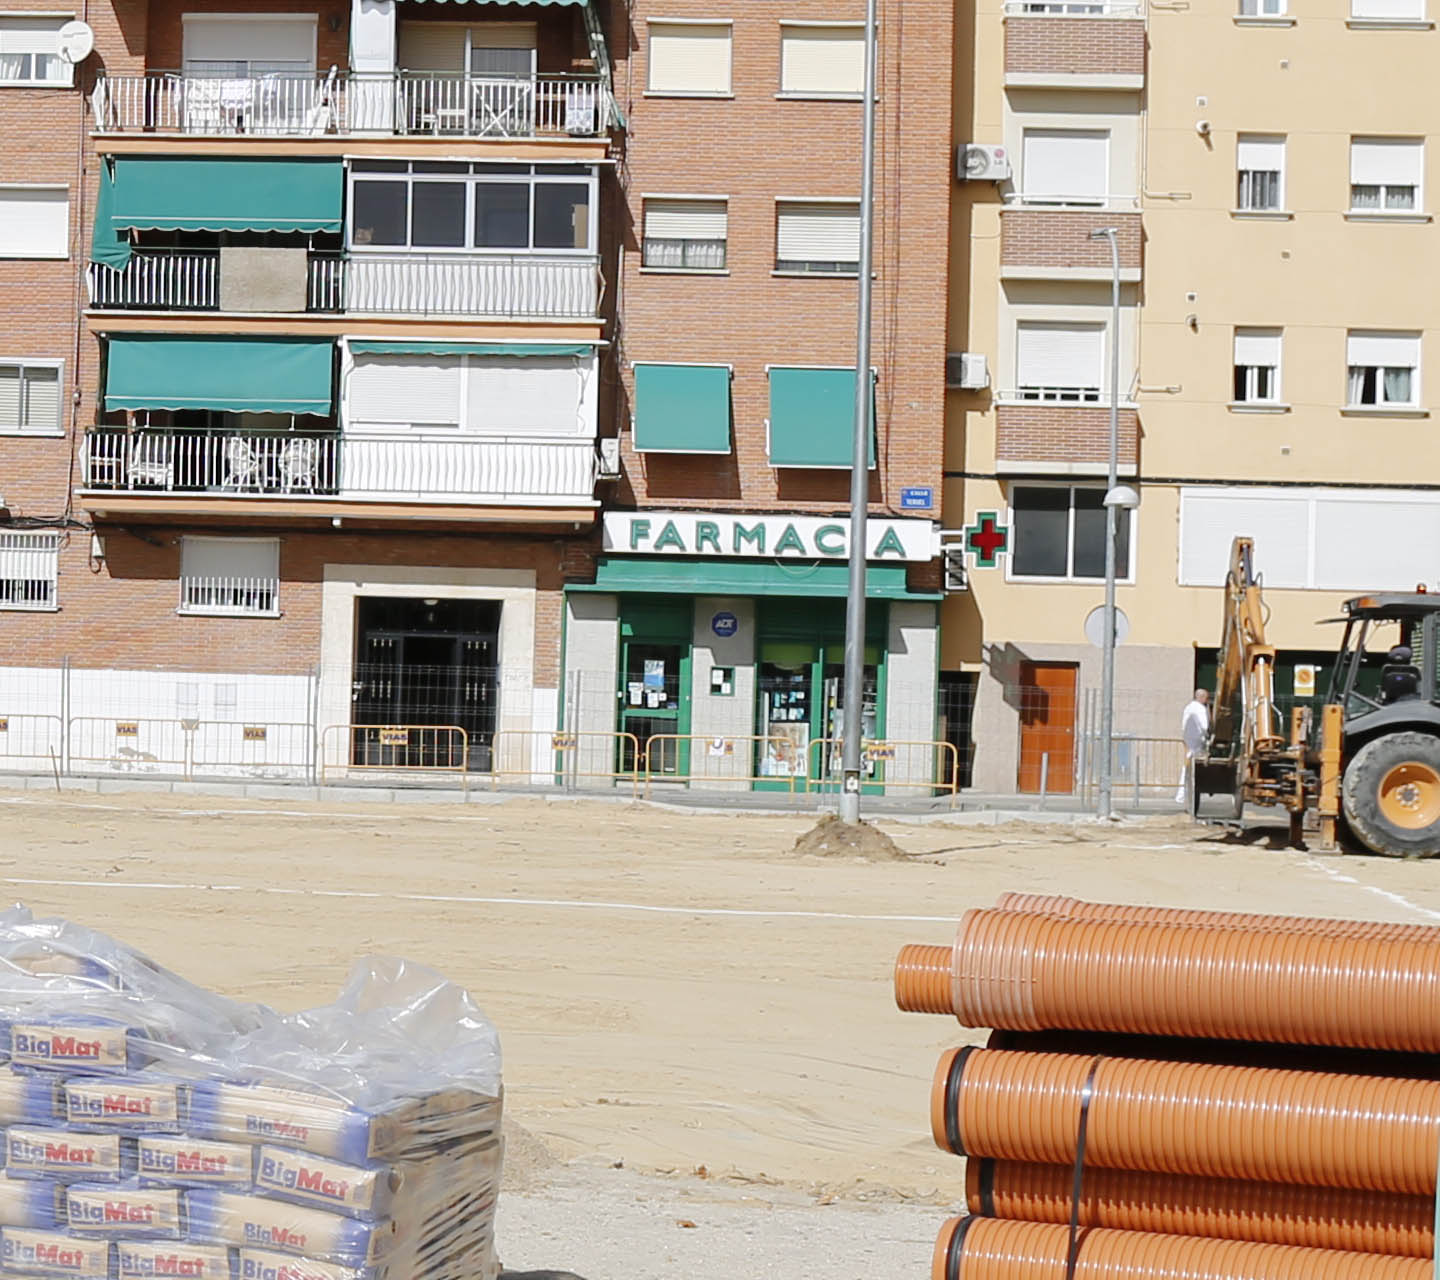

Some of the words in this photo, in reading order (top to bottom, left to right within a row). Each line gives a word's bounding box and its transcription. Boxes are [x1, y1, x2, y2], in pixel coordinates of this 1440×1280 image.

[630, 519, 906, 558] FARMACA
[16, 1034, 102, 1057] BigMat
[69, 1094, 153, 1116] BigMat
[246, 1114, 309, 1142] BigMat
[10, 1140, 95, 1163] BigMat
[141, 1148, 227, 1172] BigMat
[261, 1156, 349, 1198] BigMat
[68, 1200, 154, 1222] BigMat
[244, 1222, 307, 1248] BigMat
[2, 1238, 84, 1268] BigMat
[120, 1254, 205, 1278] BigMat
